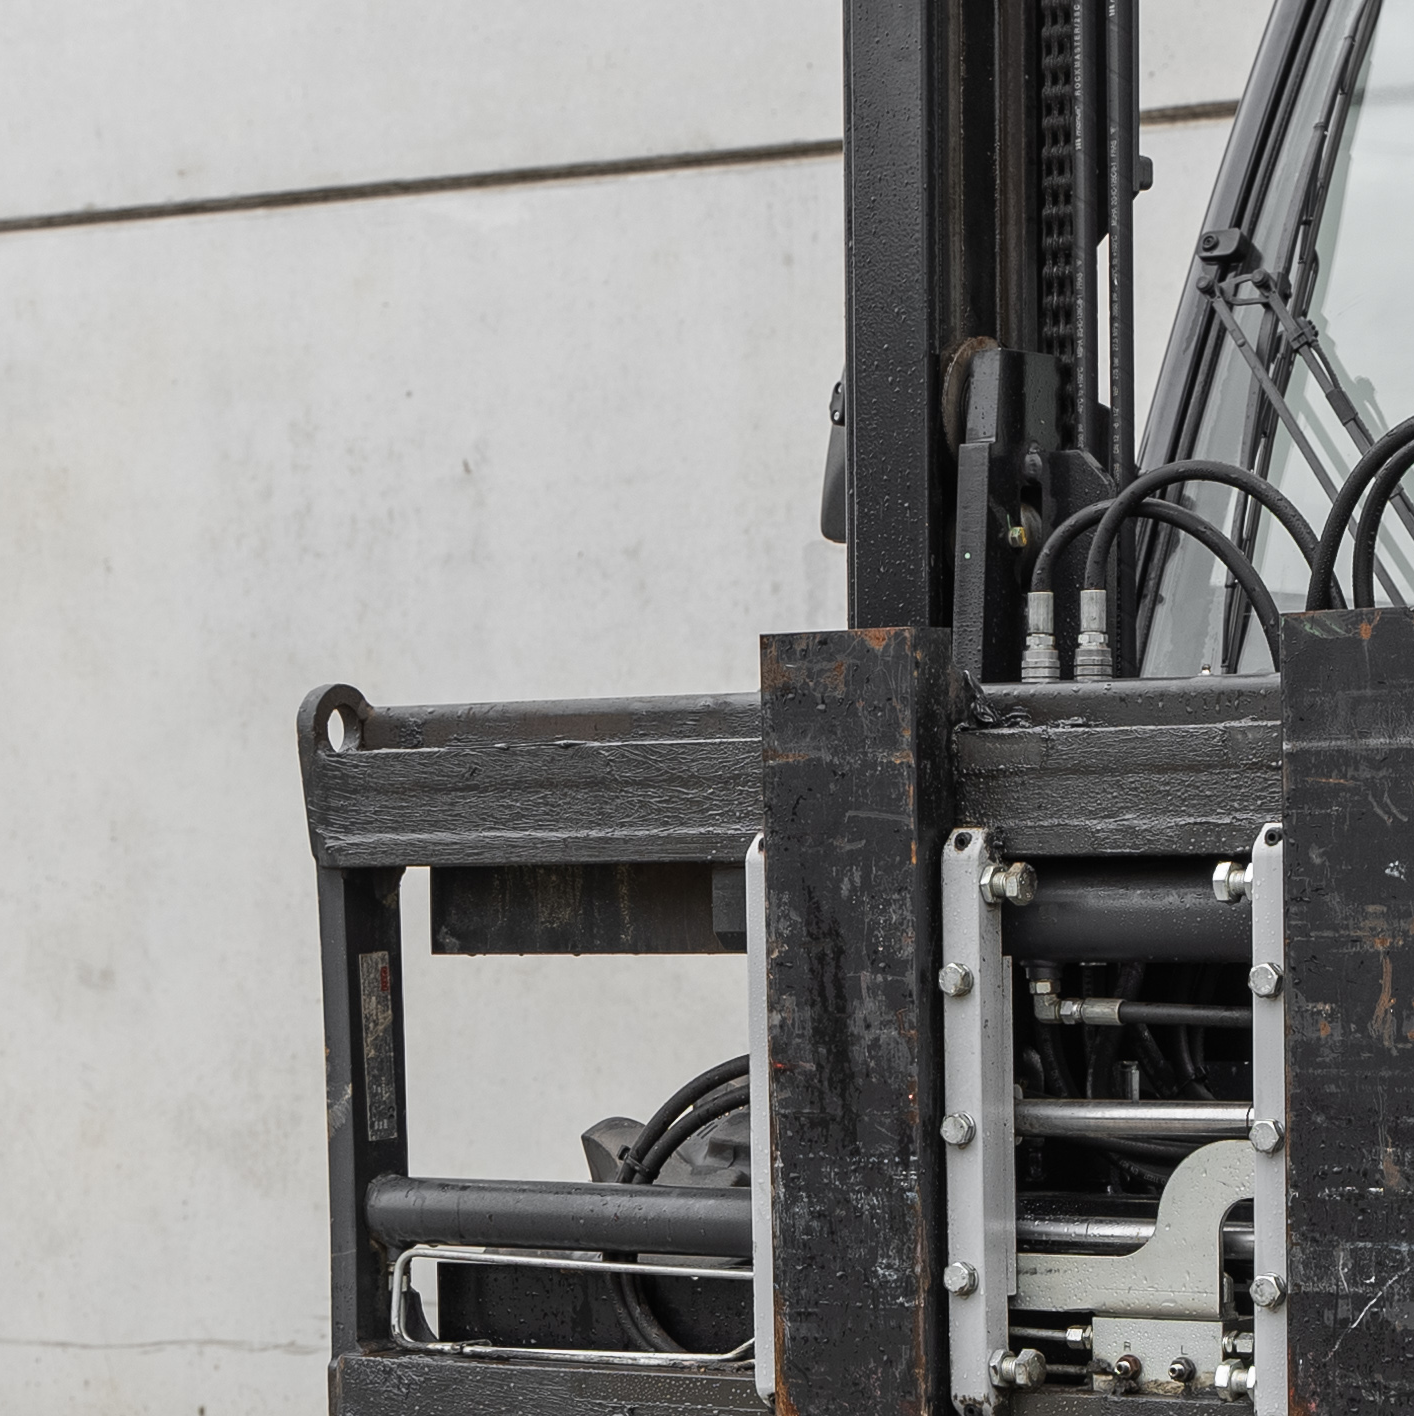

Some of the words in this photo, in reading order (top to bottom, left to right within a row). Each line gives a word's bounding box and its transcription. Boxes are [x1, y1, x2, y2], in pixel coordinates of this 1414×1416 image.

[1073, 3, 1082, 97] ROCKMASTER/2SC
[1123, 1341, 1132, 1352] R
[1180, 1344, 1189, 1356] L
